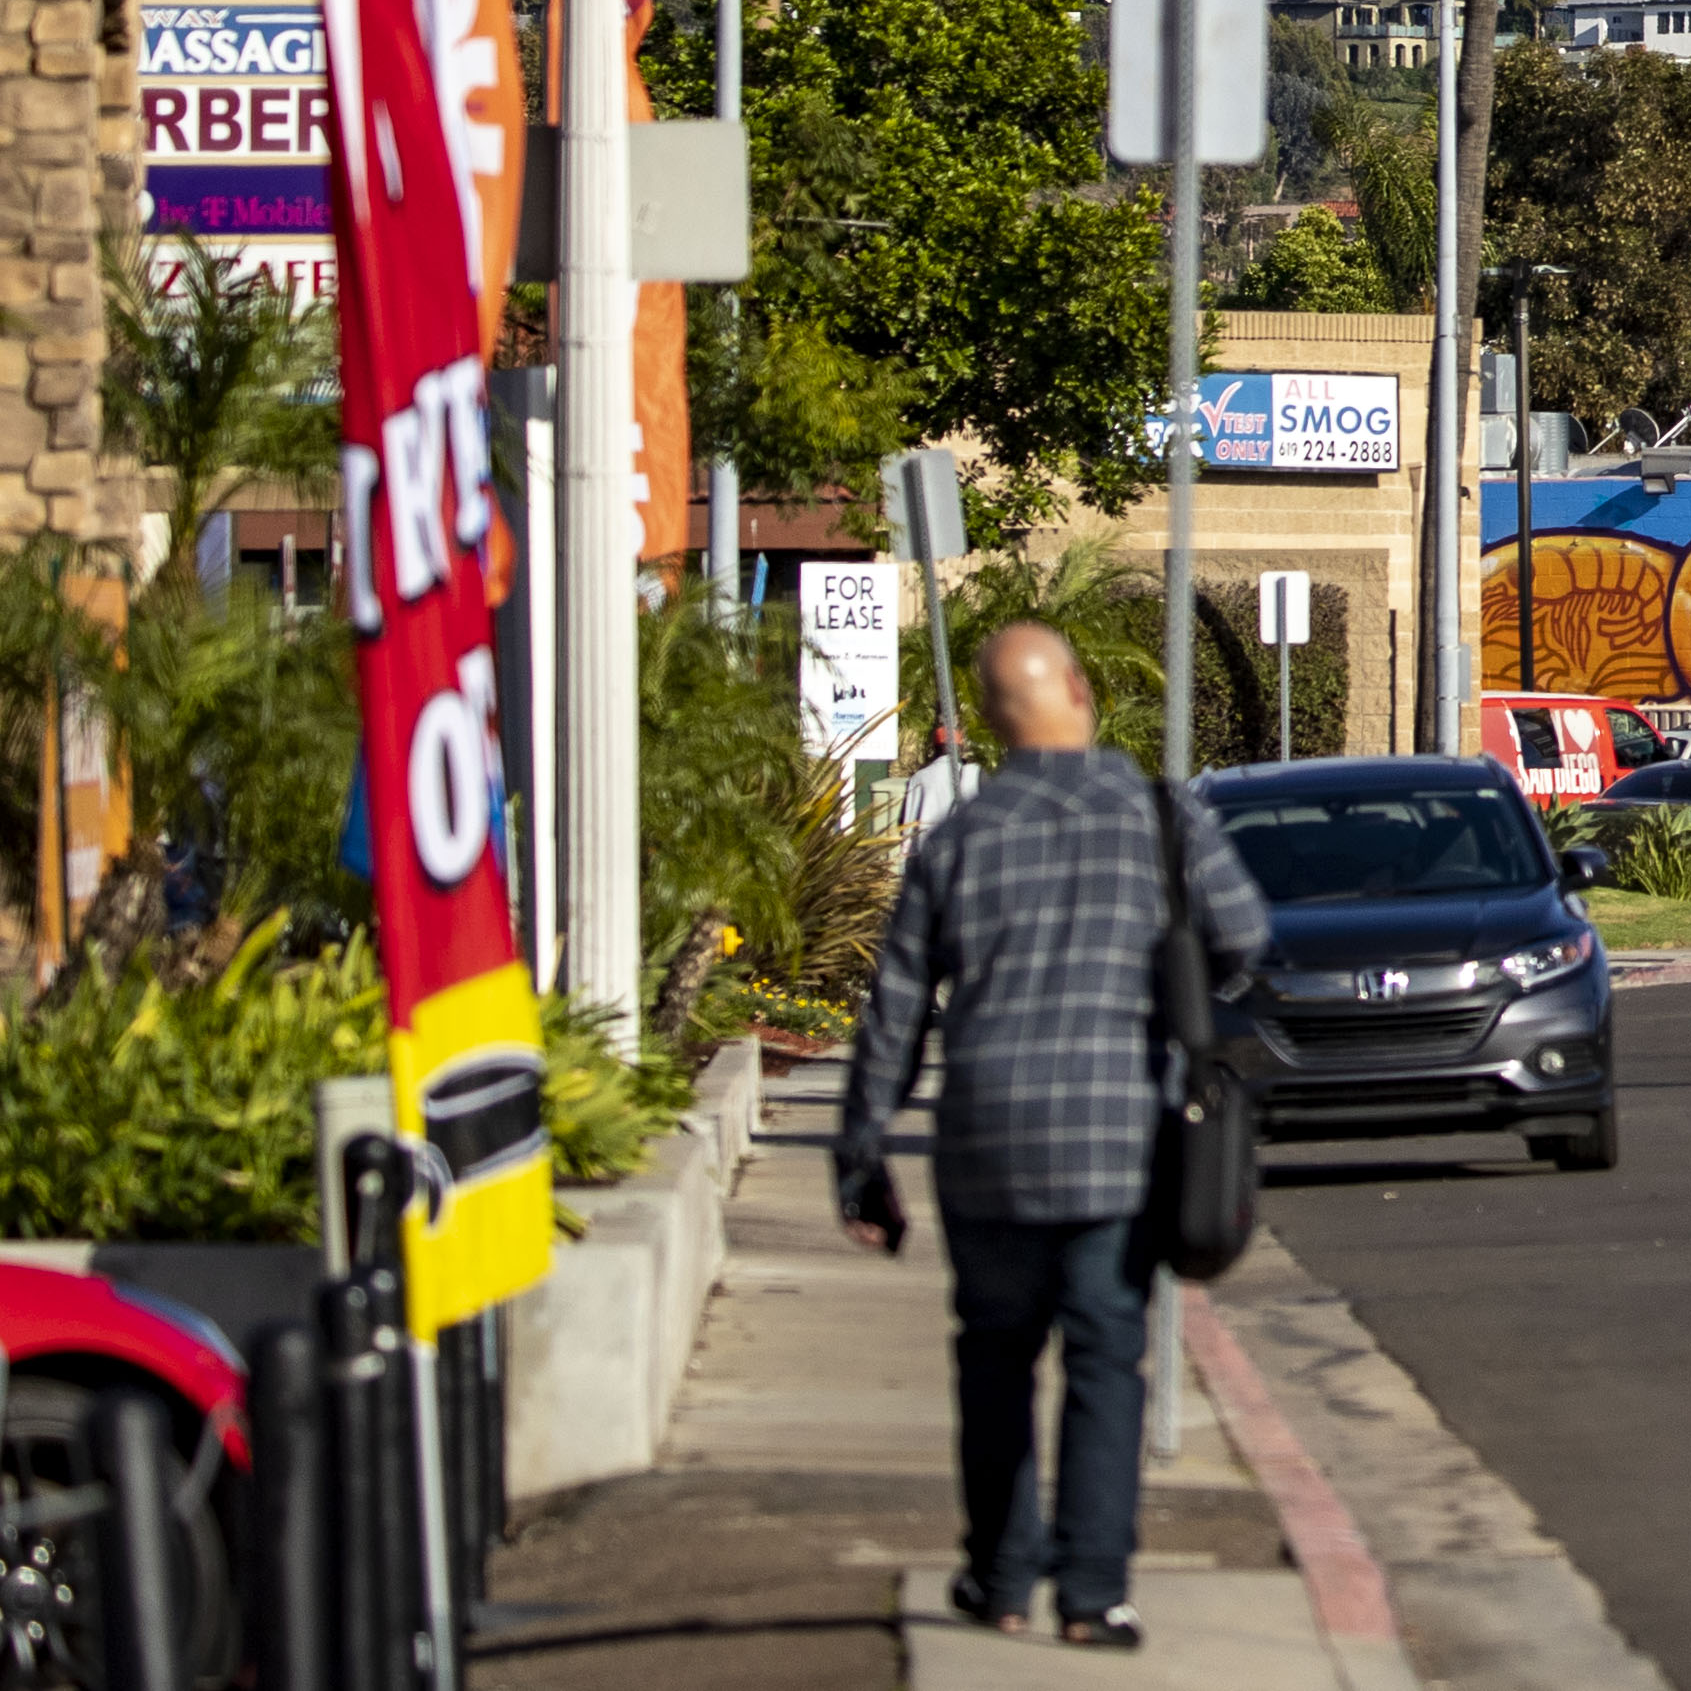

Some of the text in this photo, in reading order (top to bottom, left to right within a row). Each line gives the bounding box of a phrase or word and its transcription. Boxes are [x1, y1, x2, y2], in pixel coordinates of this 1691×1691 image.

[1284, 379, 1336, 400] ALL
[1223, 404, 1392, 436] TEST SMOG
[1216, 439, 1271, 461] ONLY
[1279, 440, 1393, 463] 619 224-2888
[824, 575, 875, 601] FOR
[815, 605, 884, 630] LEASE
